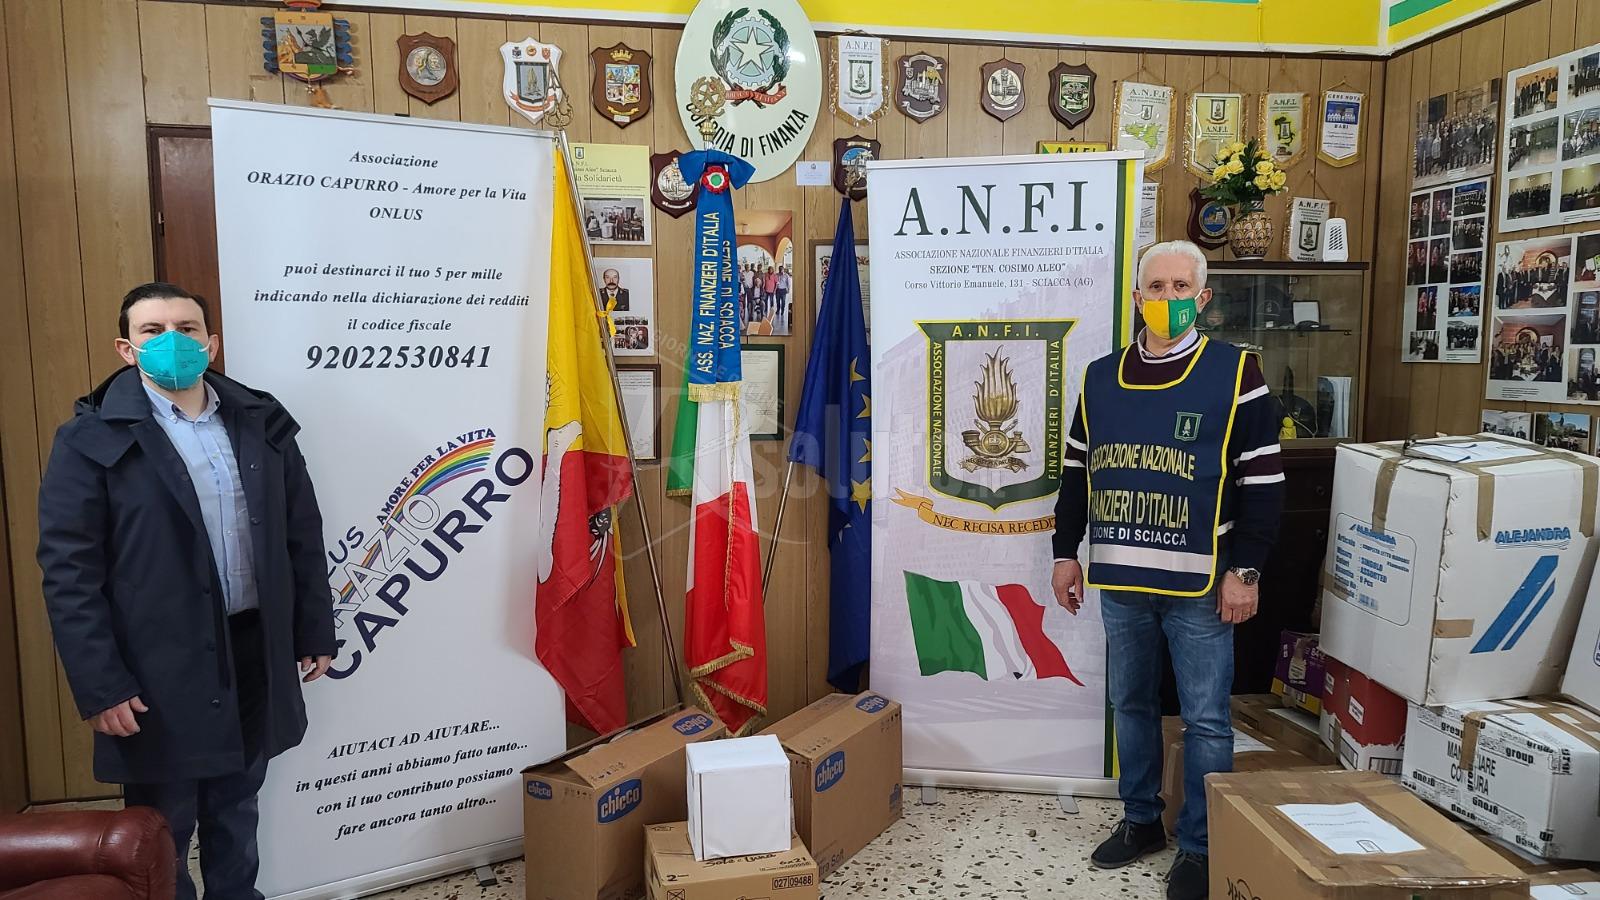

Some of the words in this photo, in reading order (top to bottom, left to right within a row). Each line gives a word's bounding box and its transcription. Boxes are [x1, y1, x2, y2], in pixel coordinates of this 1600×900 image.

[740, 137, 753, 157] DI
[758, 104, 809, 156] FINANZA
[350, 152, 438, 168] Associazione
[248, 172, 314, 186] ORAZIO
[321, 177, 398, 192] CAPURRO
[412, 183, 456, 195] Amore
[459, 189, 481, 199] per
[485, 188, 496, 198] la
[503, 189, 526, 200] Vita
[370, 207, 423, 220] ONLUS
[894, 181, 1103, 236] A.N.F.I.
[702, 211, 720, 257] D'ITALIA
[895, 250, 957, 259] ASSOCIAZIONE
[960, 249, 1009, 257] NAZIONALE
[1012, 247, 1062, 256] FINANZIERI
[284, 263, 317, 277] puoi
[323, 264, 391, 276] destinarci
[396, 266, 405, 277] il
[409, 268, 429, 277] tuo
[435, 267, 442, 277] 5
[445, 271, 467, 281] per
[471, 269, 502, 280] mille
[904, 279, 928, 289] Corso
[929, 279, 962, 289] Vittorio
[963, 279, 1008, 290] Emanuele,
[1009, 279, 1024, 288] 131
[1032, 278, 1072, 288] SCIACCA
[1074, 278, 1095, 288] (AG)
[930, 265, 969, 274] SEZIONE
[999, 264, 1034, 272] COSIMO
[255, 290, 327, 302] indicando
[333, 292, 366, 302] nella
[372, 292, 462, 305] dichiarazione
[466, 294, 485, 305] dei
[489, 295, 529, 305] redditi
[699, 261, 717, 317] FINANZIERI
[348, 319, 357, 329] il
[362, 319, 404, 330] codice
[407, 320, 451, 333] fiscale
[697, 320, 715, 346] NAZ.
[718, 302, 736, 349] SCIACCA
[951, 325, 1040, 338] A.N.F.I.
[307, 346, 490, 369] 92022530841
[697, 351, 714, 374] ASS.
[1049, 340, 1060, 397] D'ITALIA
[932, 342, 943, 416] ASSOCIAZIONE
[932, 418, 943, 477] NAZIONALE
[1048, 407, 1059, 480] FINANZIERI
[1139, 444, 1196, 481] NAZIONALE
[375, 477, 413, 525] AMORE
[410, 455, 437, 480] PER
[933, 514, 960, 530] NEC
[962, 517, 1005, 534] RECISA
[1135, 491, 1189, 530] D'ITALIA
[1118, 527, 1130, 541] DI
[1134, 528, 1187, 546] SCIACCA
[1494, 526, 1571, 544] ALEJANDRA
[325, 447, 534, 680] CAPURRO
[332, 494, 440, 629] RAZIO
[327, 736, 395, 759] AIUTACI
[399, 733, 420, 746] AD
[424, 720, 499, 741] AIUTARE...
[296, 781, 309, 792] in
[315, 770, 357, 791] questi
[361, 763, 392, 778] anni
[396, 755, 450, 772] abbiamo
[453, 749, 482, 764] fatto
[487, 743, 527, 755] tanto...
[1505, 747, 1534, 764] group
[816, 757, 844, 788] chicco
[317, 802, 341, 814] con
[347, 796, 356, 808] il
[361, 794, 382, 805] tuo
[387, 780, 453, 799] contributo
[456, 768, 513, 788] possiamo
[600, 787, 641, 819] chicco
[335, 824, 365, 840] fare
[370, 813, 415, 829] ancora
[421, 805, 452, 818] tanto
[457, 798, 496, 810] altro...
[773, 878, 788, 889] 027
